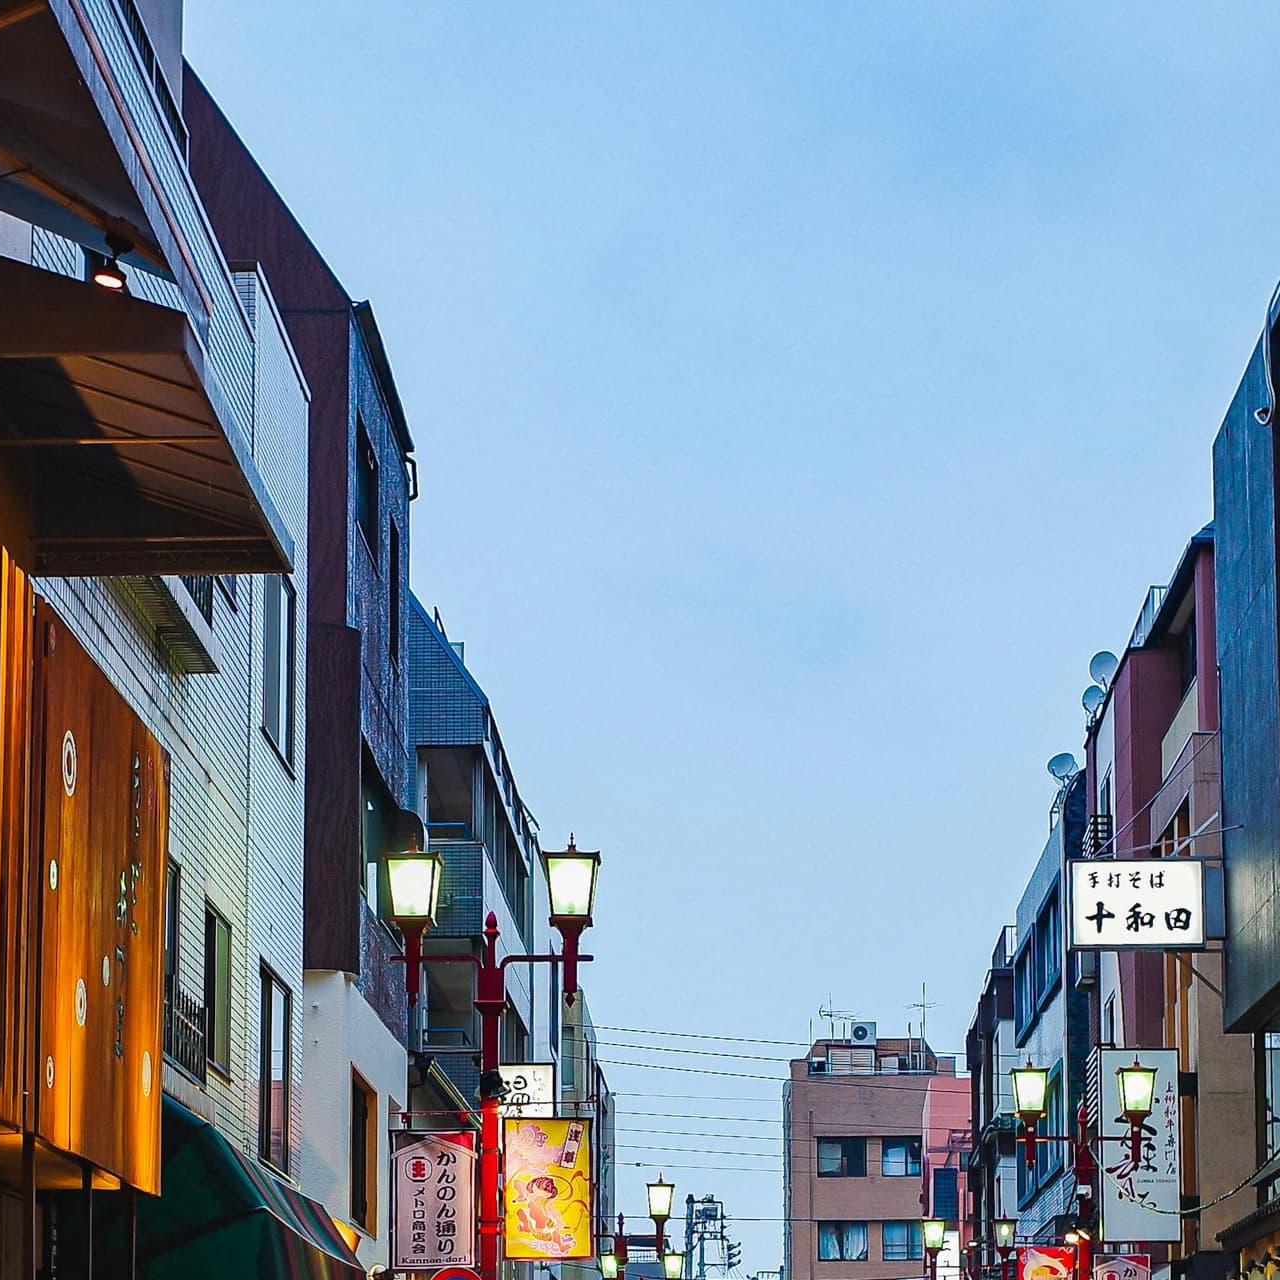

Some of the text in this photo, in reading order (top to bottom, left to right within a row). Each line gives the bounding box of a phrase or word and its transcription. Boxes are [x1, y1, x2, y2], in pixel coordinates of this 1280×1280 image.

[1088, 873, 1165, 889] 手打そば
[1085, 902, 1192, 933] 十和田
[435, 1151, 458, 1255] かんのん通り
[411, 1187, 428, 1254] メトロ商店会
[401, 1255, 467, 1265] Kannon-dori
